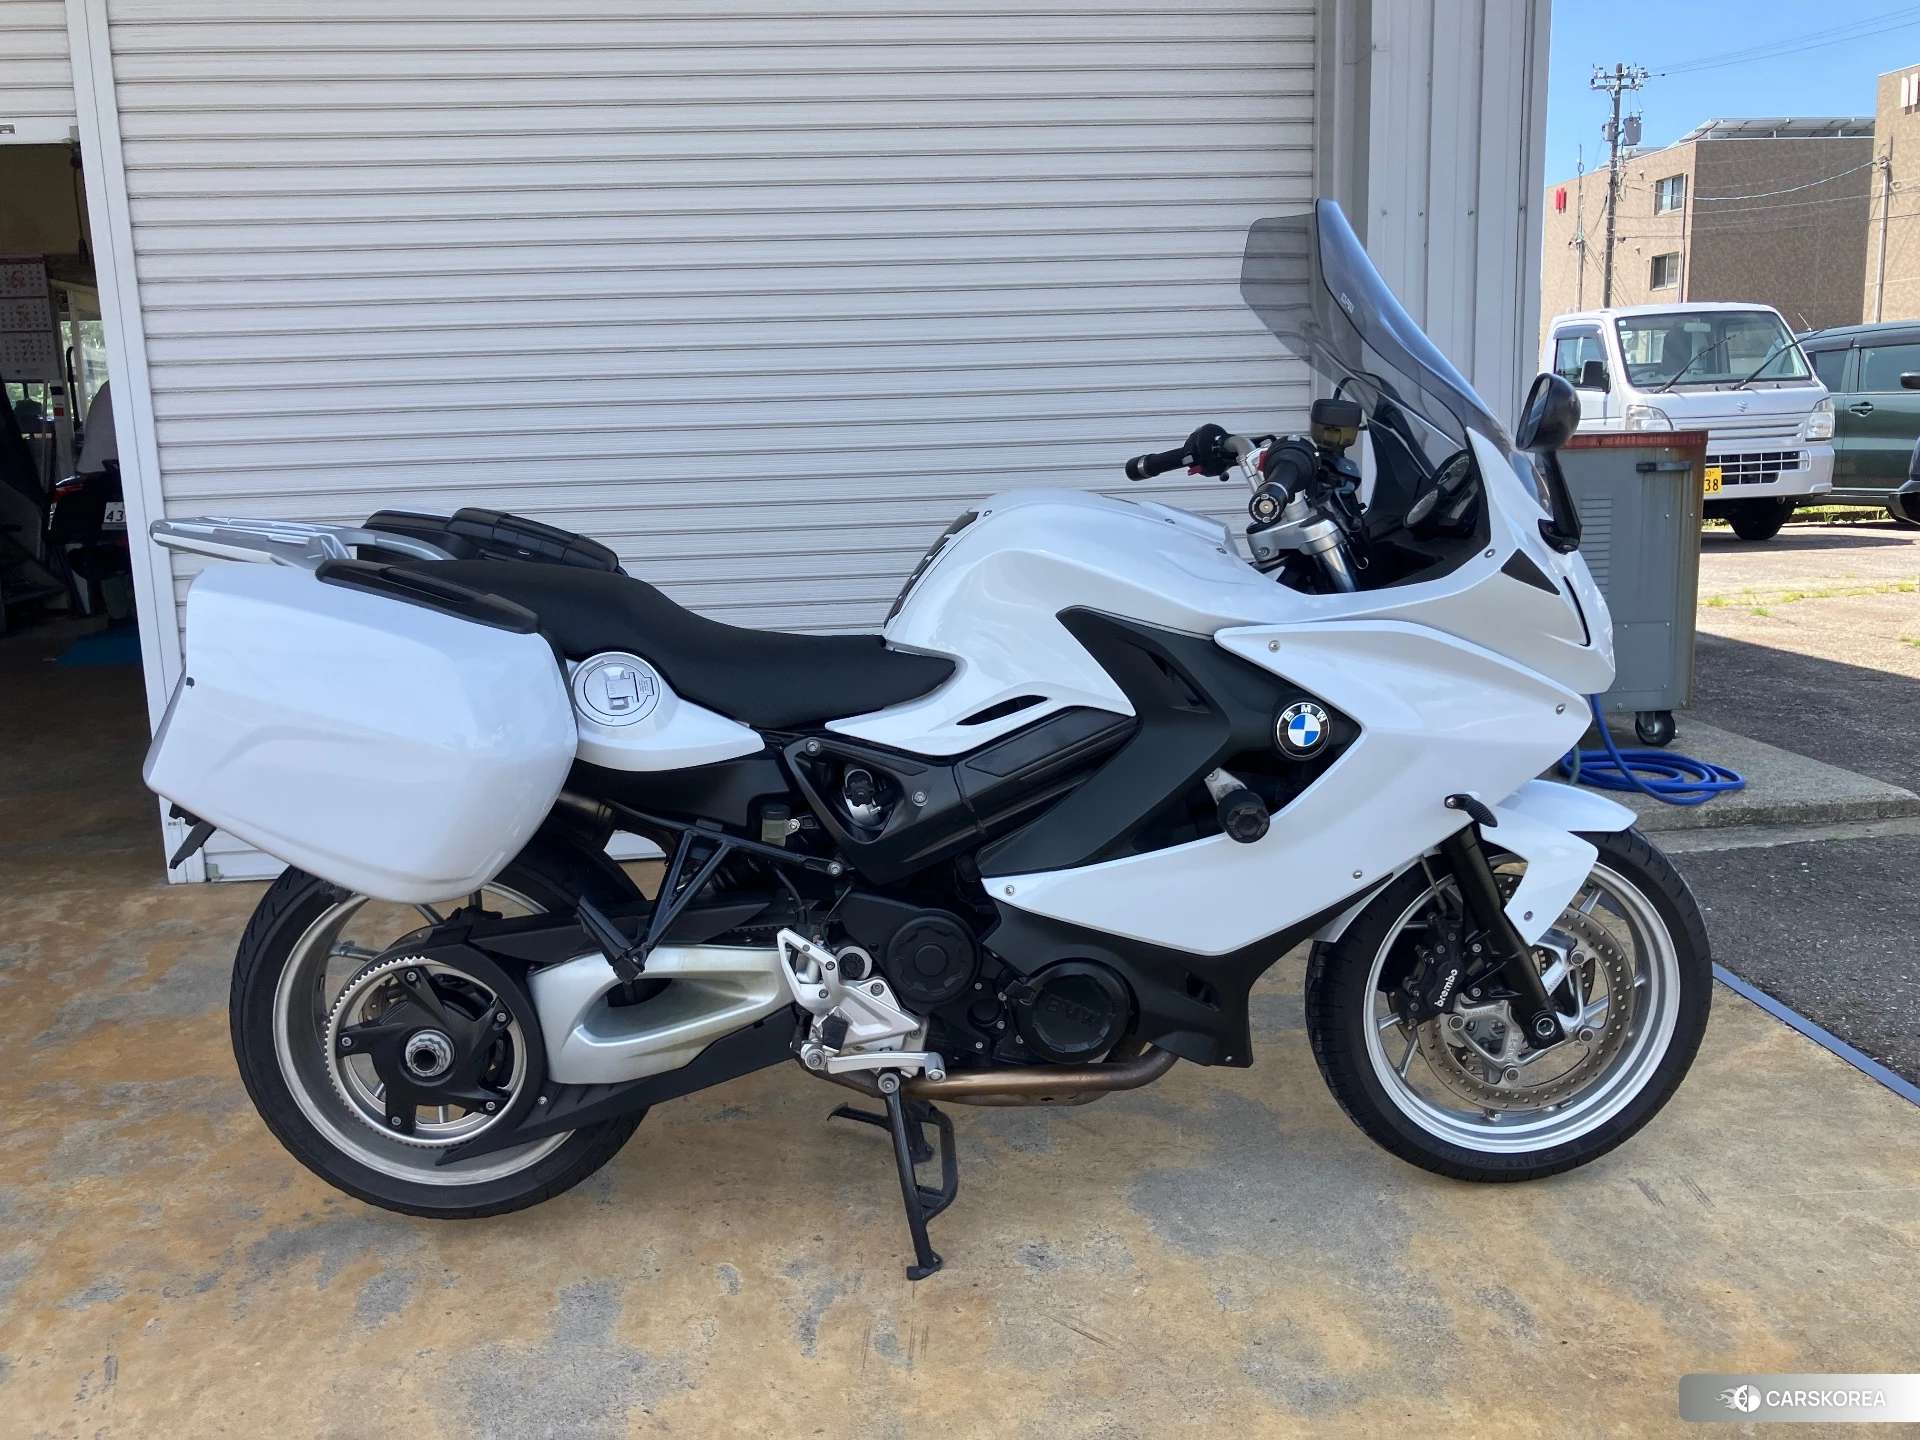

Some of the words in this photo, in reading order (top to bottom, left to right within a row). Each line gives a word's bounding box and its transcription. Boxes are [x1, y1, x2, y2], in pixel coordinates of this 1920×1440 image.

[1705, 479, 1719, 491] 38
[106, 510, 124, 521] 43
[1283, 704, 1327, 722] BMW
[1434, 969, 1458, 1007] brembo
[1046, 993, 1103, 1028] BMW
